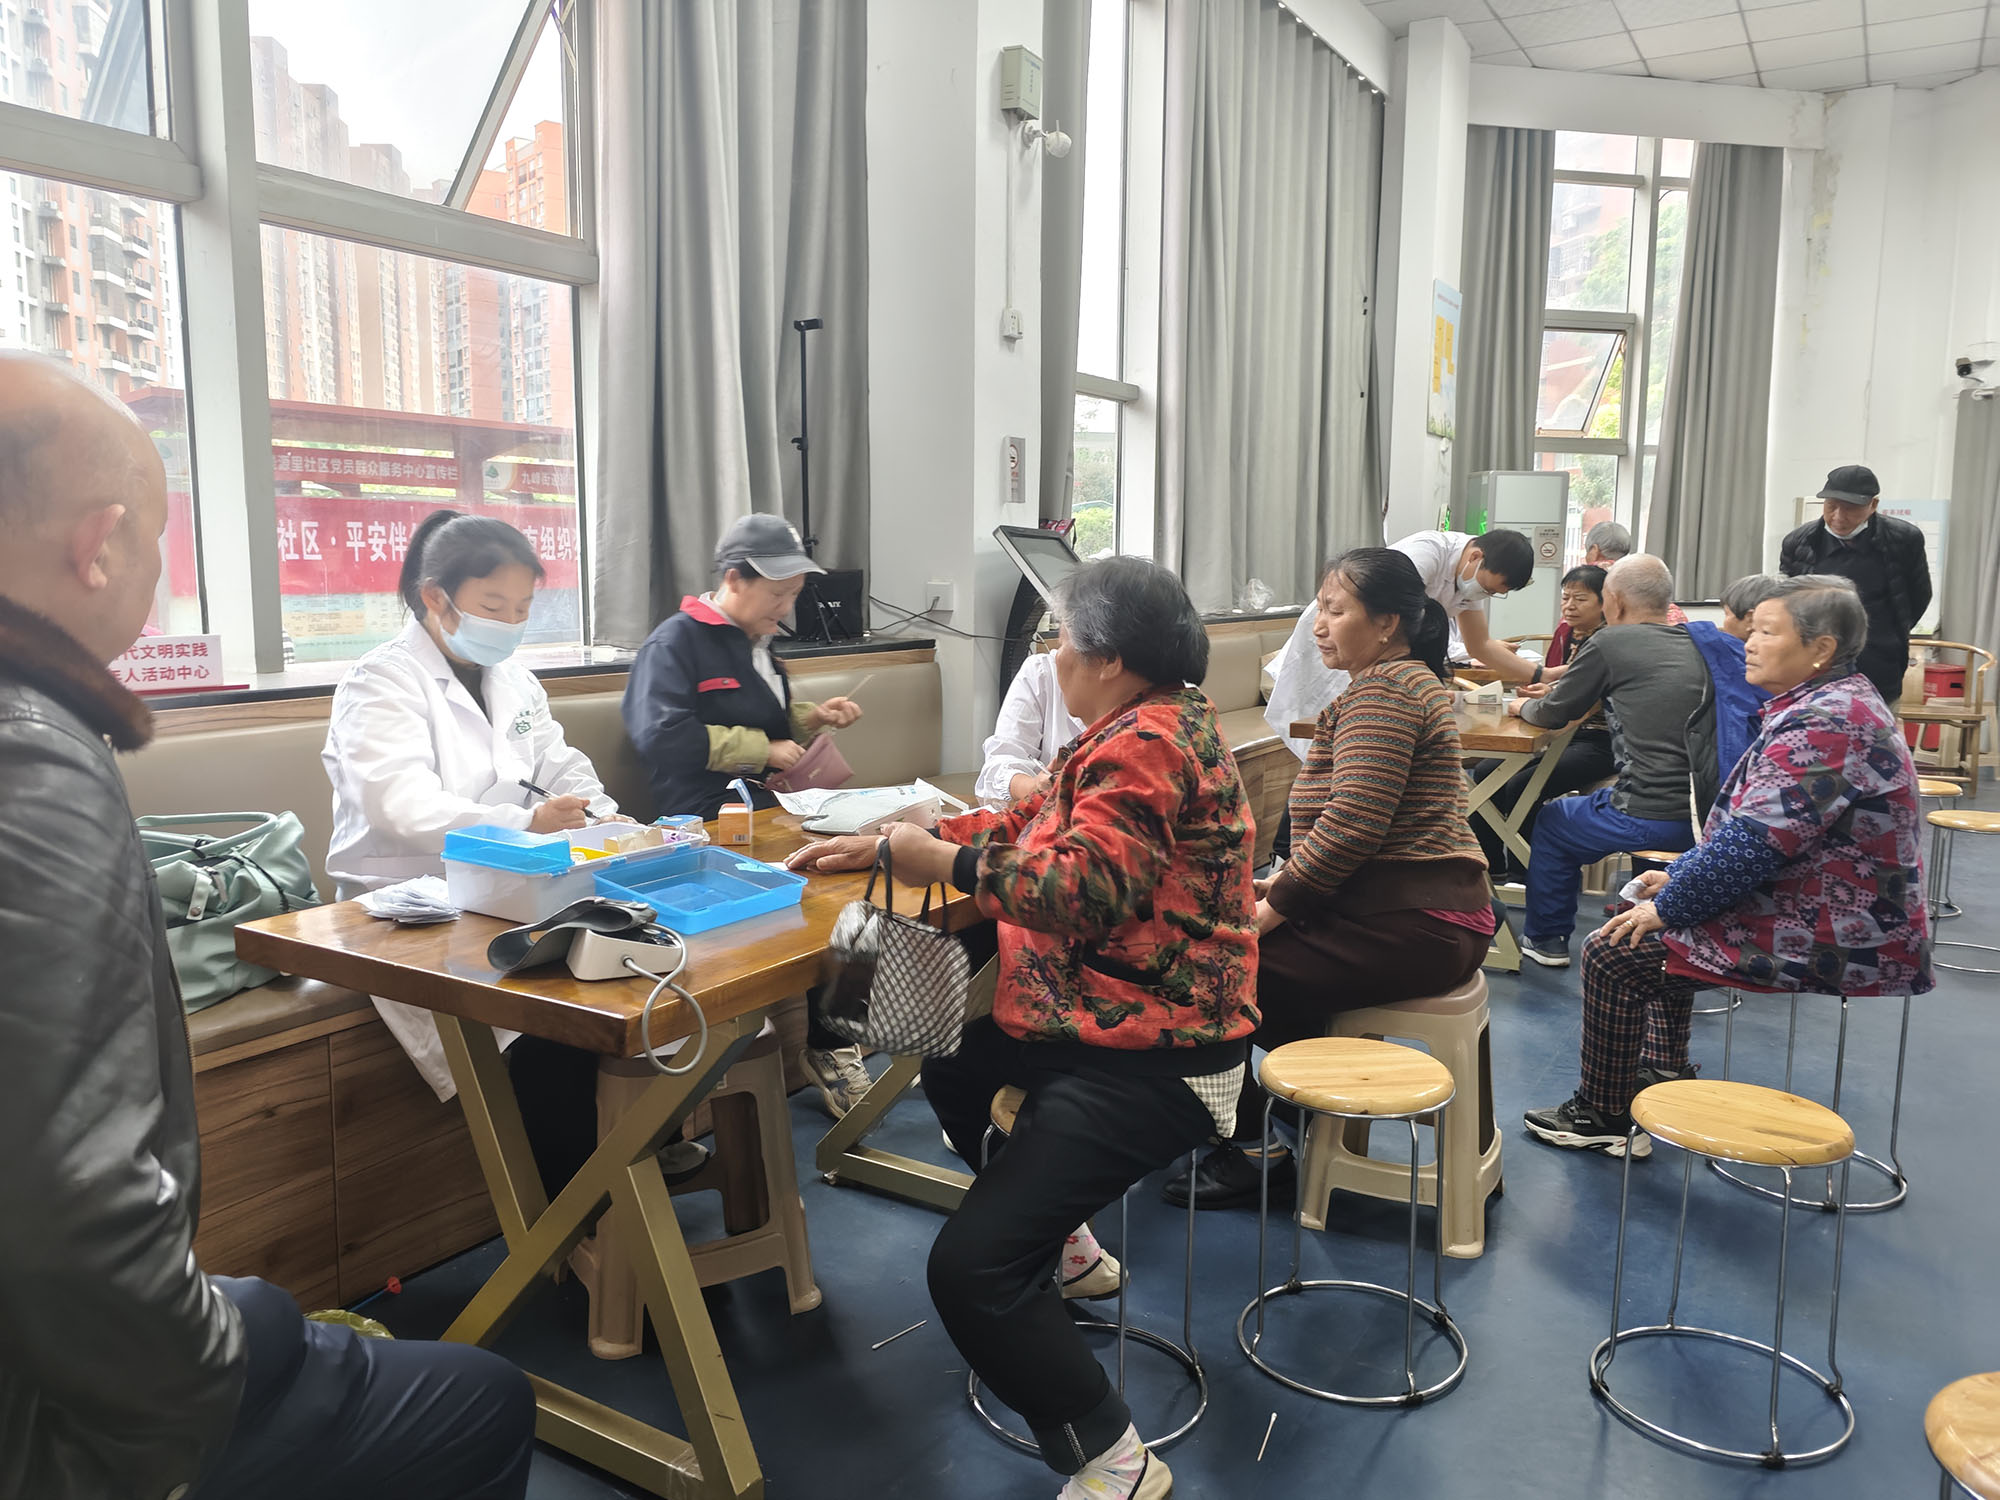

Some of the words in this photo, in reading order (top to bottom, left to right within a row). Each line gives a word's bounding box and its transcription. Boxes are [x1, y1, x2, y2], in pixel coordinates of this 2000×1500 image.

[272, 454, 459, 481] 源里社区党员群众服务中心宣传栏
[115, 642, 209, 661] 代文明实践
